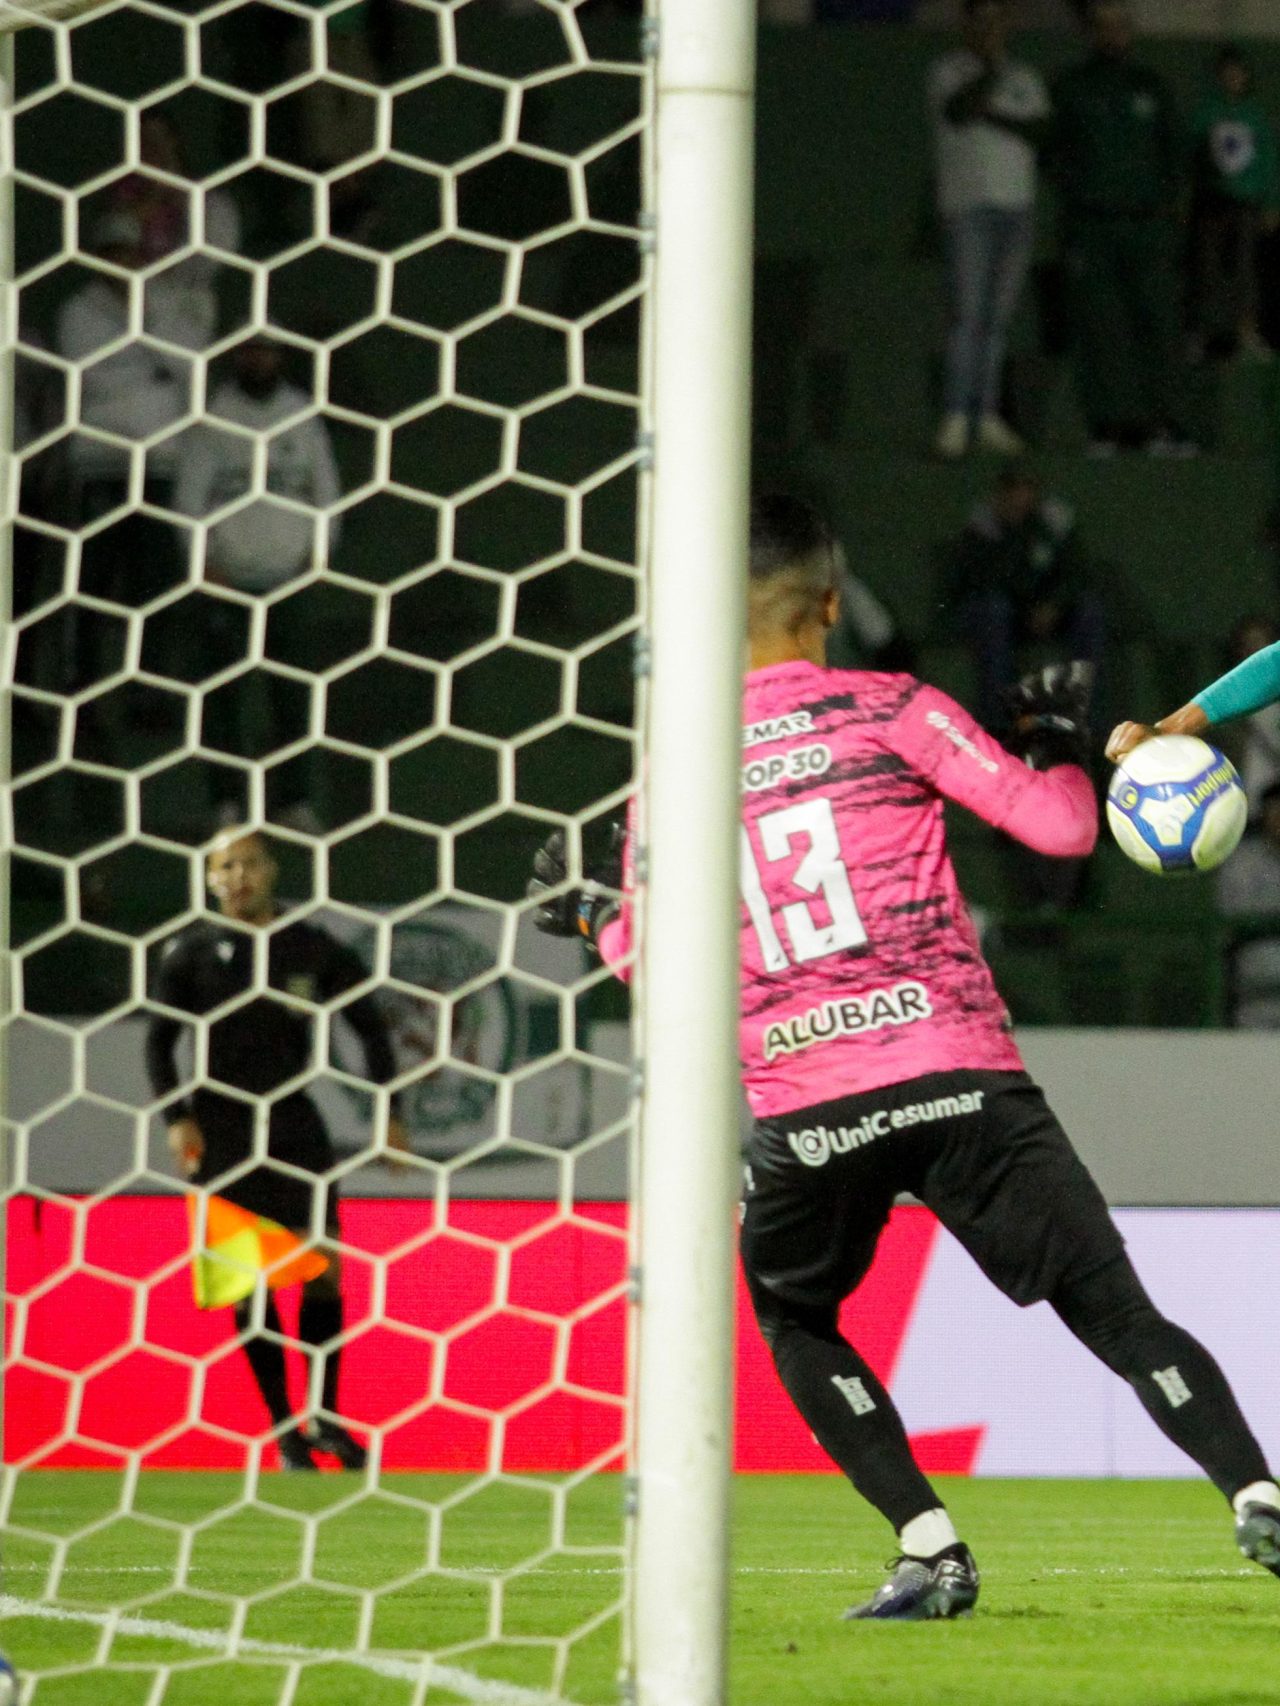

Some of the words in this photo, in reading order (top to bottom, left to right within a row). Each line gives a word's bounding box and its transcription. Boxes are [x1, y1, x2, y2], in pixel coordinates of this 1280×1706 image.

[791, 745, 828, 777] 30
[738, 797, 868, 973] 13
[764, 984, 931, 1059] ALUBAR
[828, 1090, 985, 1154] UniCesumar
